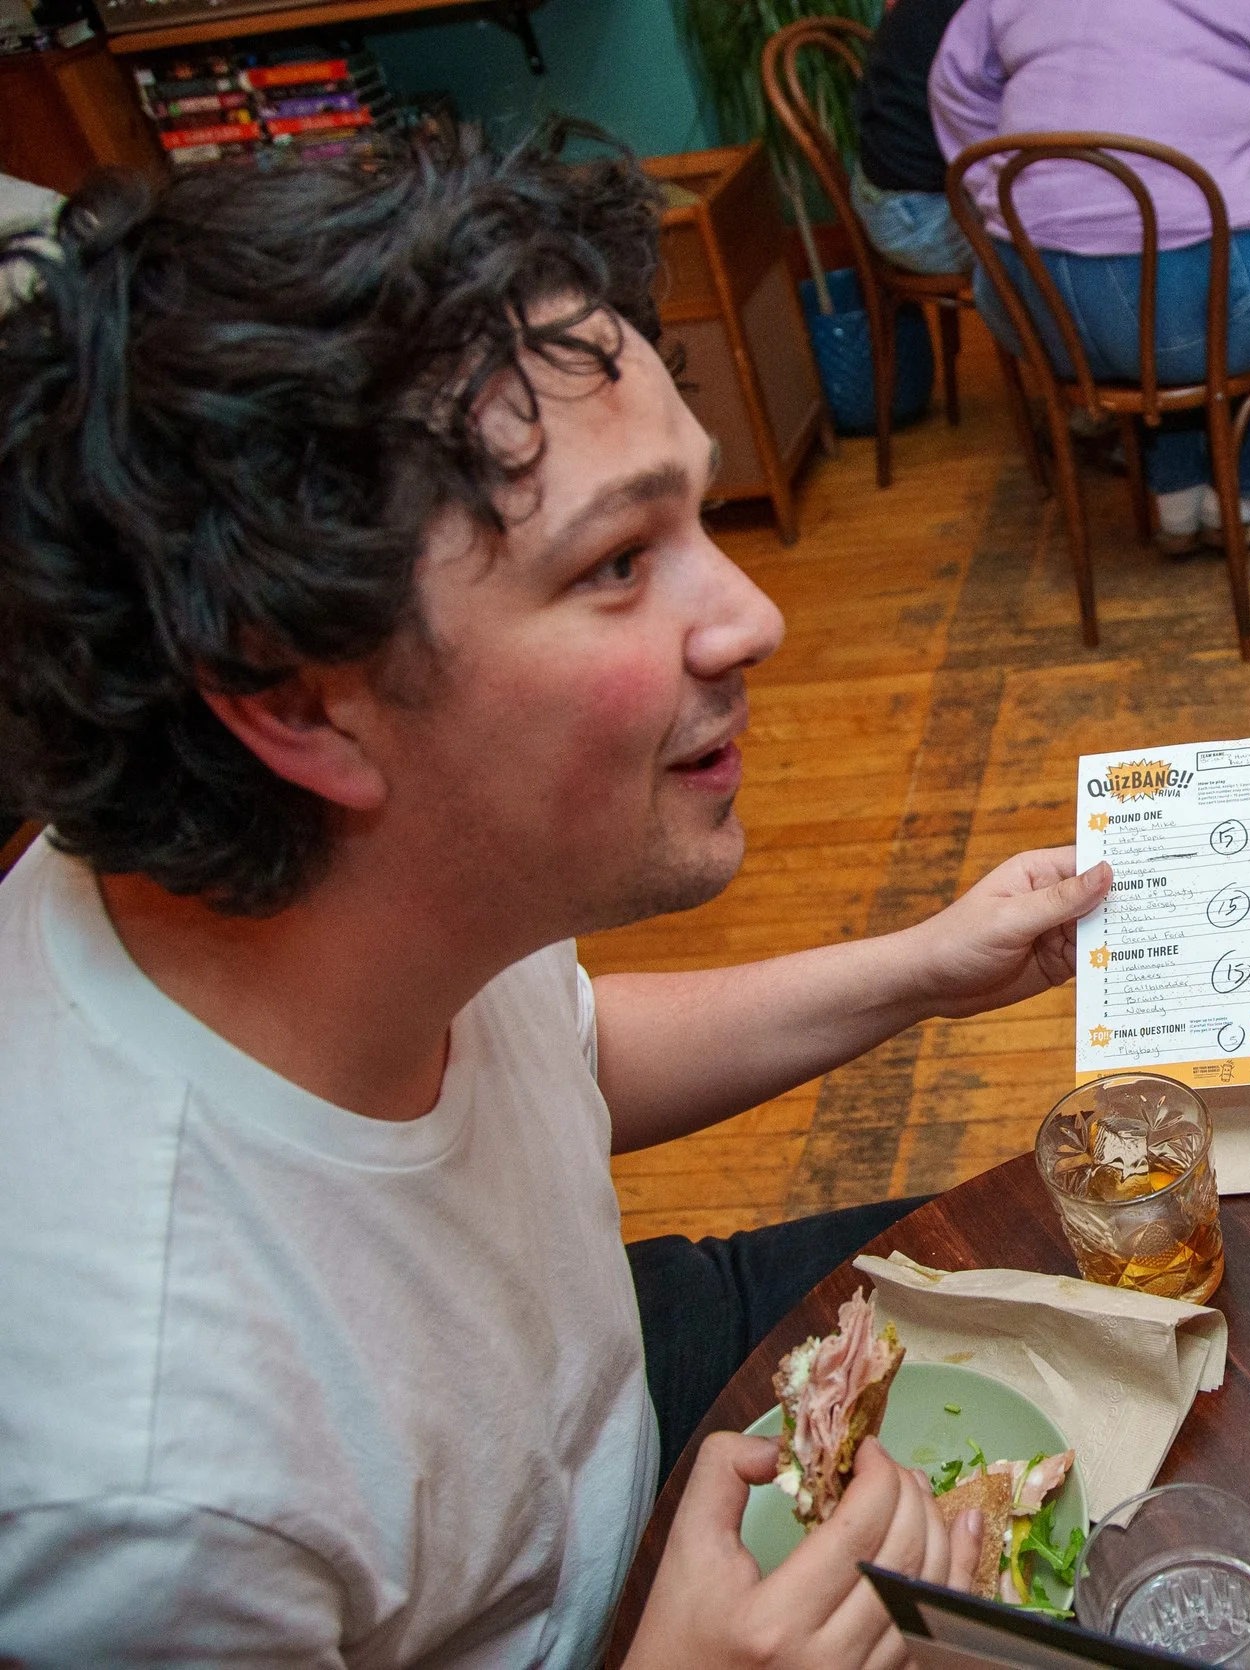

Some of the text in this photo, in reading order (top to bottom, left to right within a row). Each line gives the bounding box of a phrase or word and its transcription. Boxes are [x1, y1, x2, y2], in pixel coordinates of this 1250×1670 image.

[1087, 769, 1194, 798] QuizBANG!!
[1155, 788, 1180, 797] TRIVIA
[1108, 813, 1140, 824] ROUND
[1144, 810, 1163, 820] ONE
[1152, 821, 1176, 830] Mike
[1111, 845, 1164, 856] Bridgerton
[1114, 867, 1156, 878] Hydrogen
[1111, 877, 1167, 892] ROUND TWO
[1147, 902, 1176, 912] Jersey
[1218, 896, 1241, 916] 15
[1122, 931, 1185, 944] Gerald Ford
[1097, 945, 1179, 963] 3 ROUND THREE
[1228, 963, 1244, 984] 15
[1126, 1005, 1166, 1017] Nobody
[1094, 1024, 1186, 1041] FQ!! FINAL QUESTION!!
[1119, 1045, 1160, 1060] Playboy
